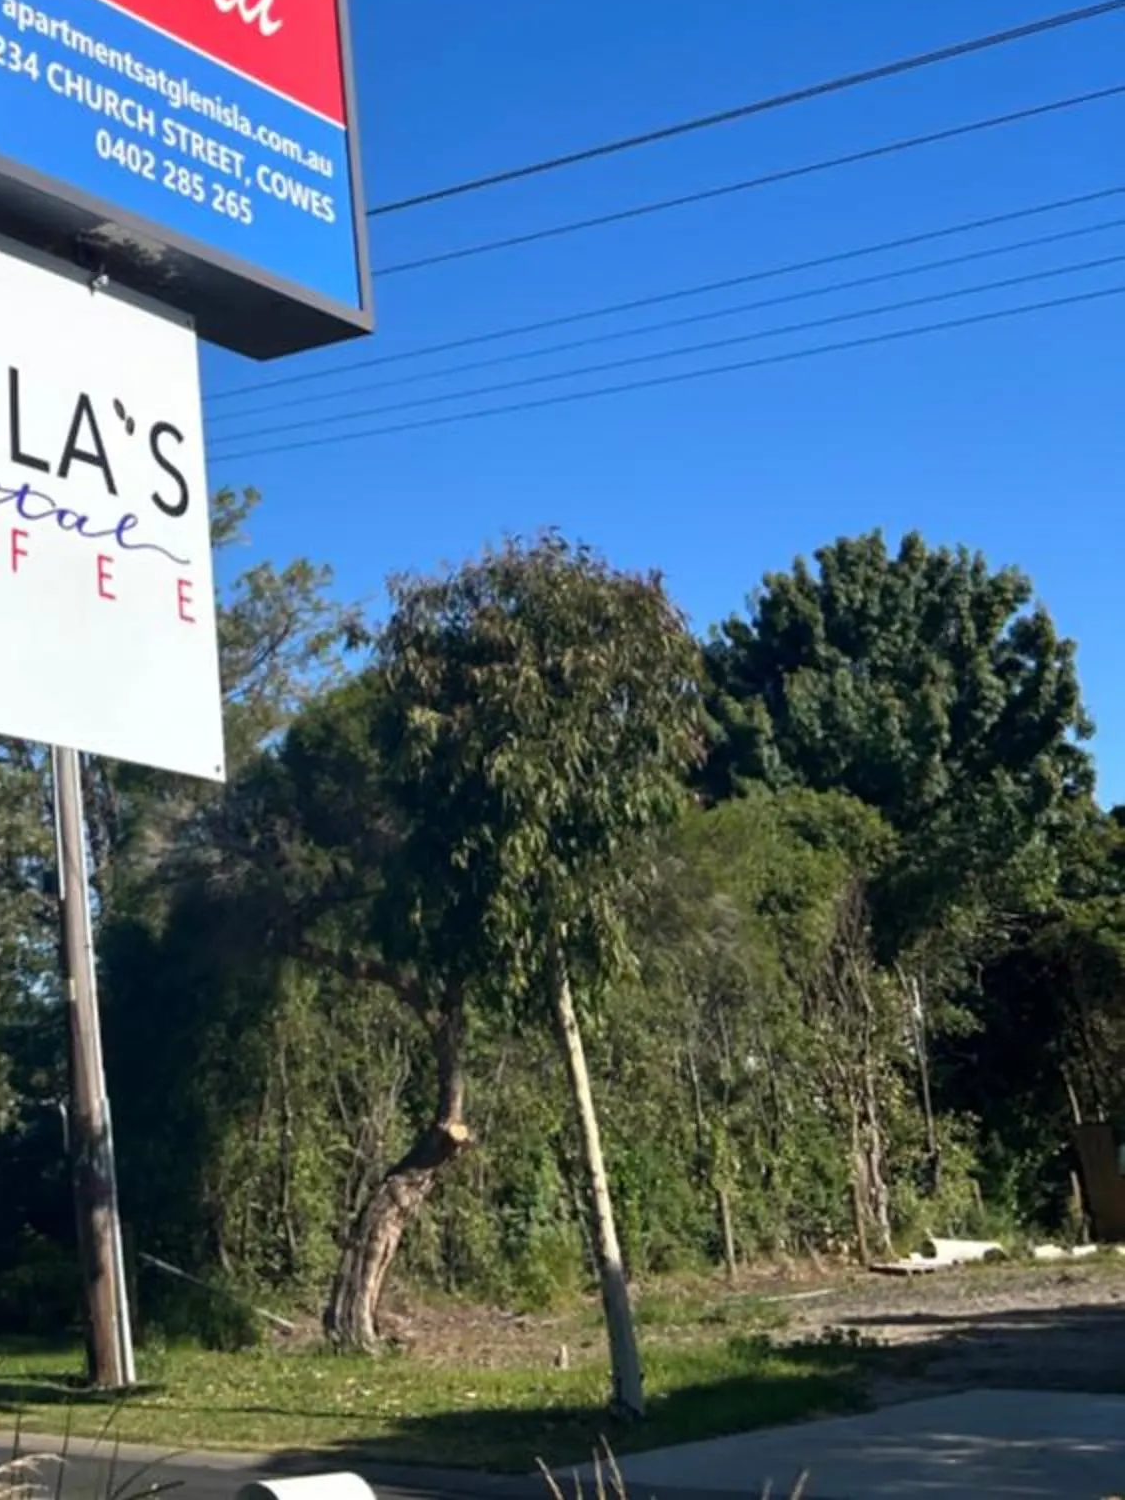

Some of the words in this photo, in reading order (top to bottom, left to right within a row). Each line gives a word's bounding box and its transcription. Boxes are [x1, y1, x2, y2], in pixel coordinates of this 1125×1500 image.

[47, 63, 156, 137] CHURCH
[162, 117, 251, 186] STREET,
[257, 165, 335, 223] COWES
[95, 130, 156, 180] 0402
[162, 161, 204, 202] 285
[212, 183, 253, 225] 265
